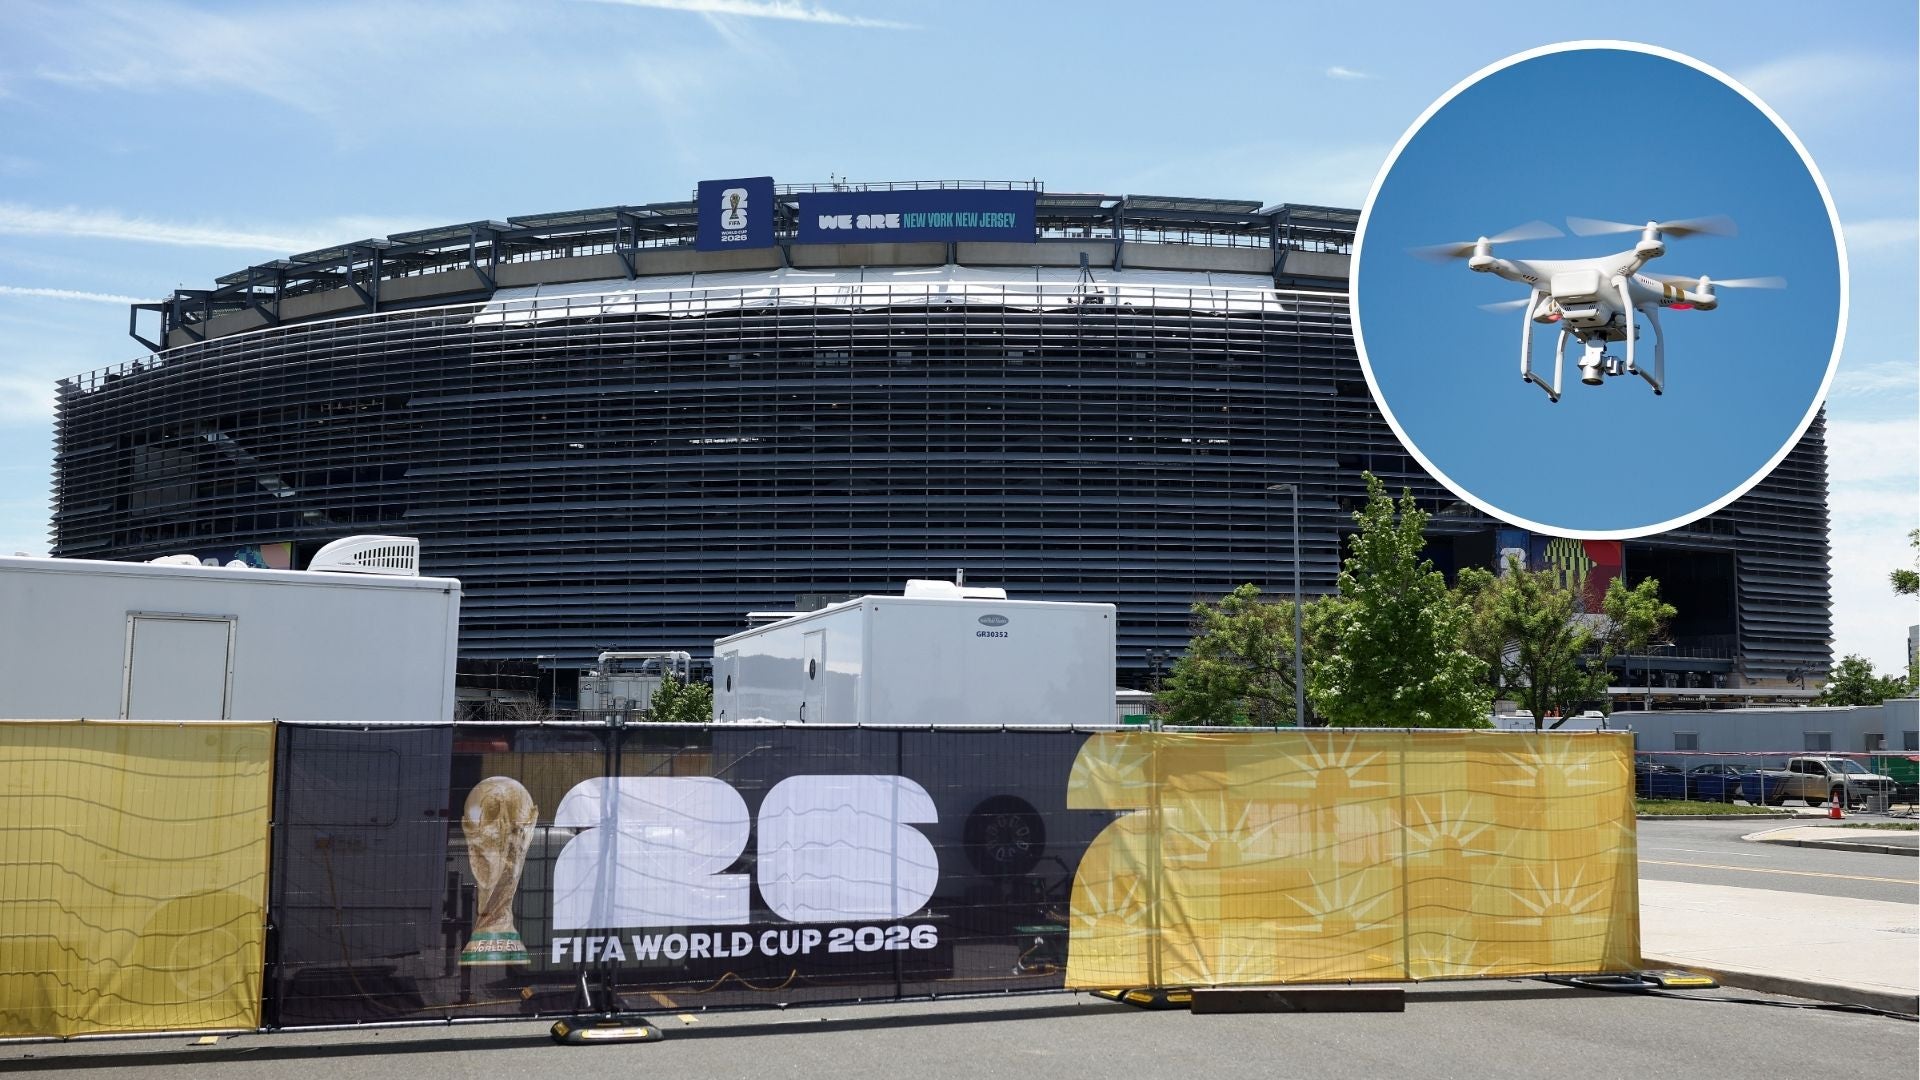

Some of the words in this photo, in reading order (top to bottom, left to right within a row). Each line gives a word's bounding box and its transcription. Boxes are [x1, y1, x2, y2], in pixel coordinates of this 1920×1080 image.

[818, 215, 853, 230] WE
[856, 213, 900, 229] ARE
[903, 212, 926, 228] NEW
[927, 212, 954, 228] YORK
[955, 212, 978, 228] NEW
[979, 212, 1016, 229] JERSEY
[551, 935, 626, 963] FIFA
[631, 931, 754, 961] WORLD
[759, 929, 822, 956] CUP
[828, 924, 939, 953] 2026
